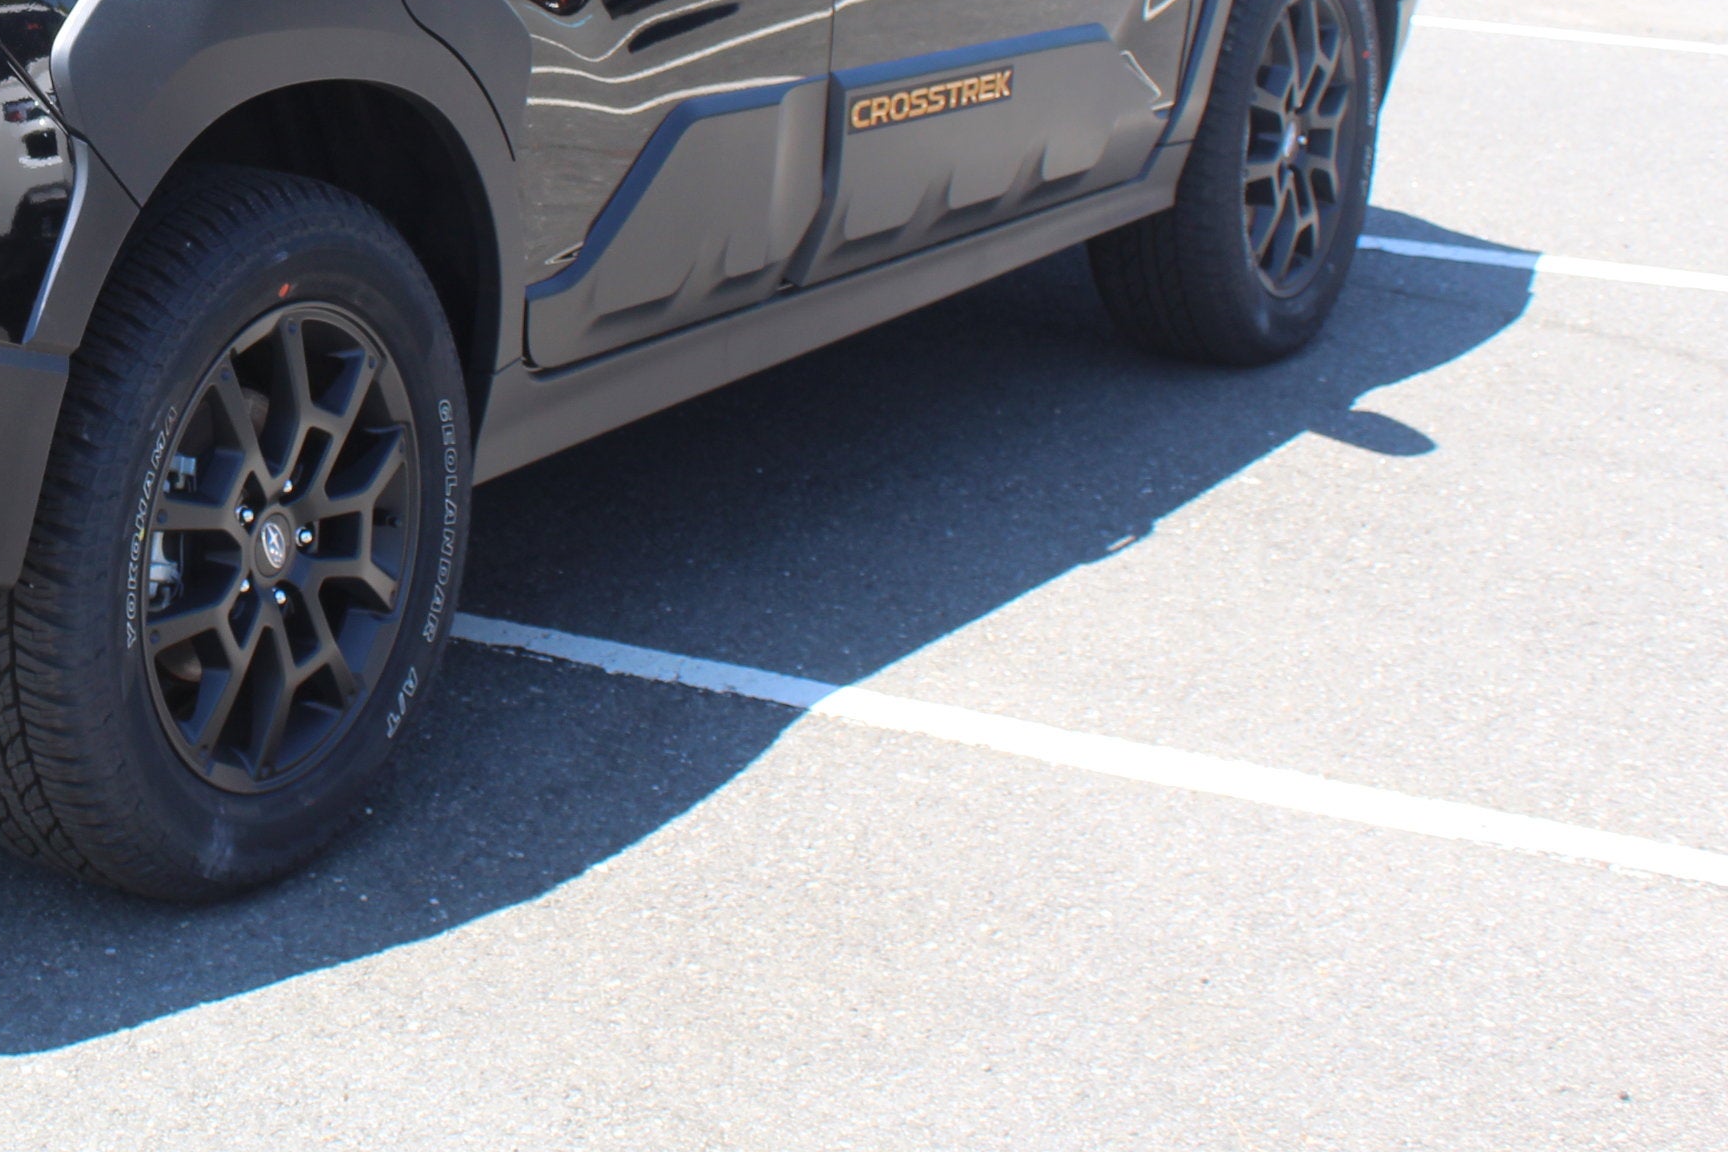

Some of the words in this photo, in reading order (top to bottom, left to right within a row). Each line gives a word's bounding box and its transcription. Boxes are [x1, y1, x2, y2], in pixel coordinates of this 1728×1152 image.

[850, 69, 1012, 129] CROSSTREK
[127, 406, 177, 648] YOKOHAMA
[422, 398, 458, 643] GEOLANDAR
[386, 665, 418, 739] A/T
